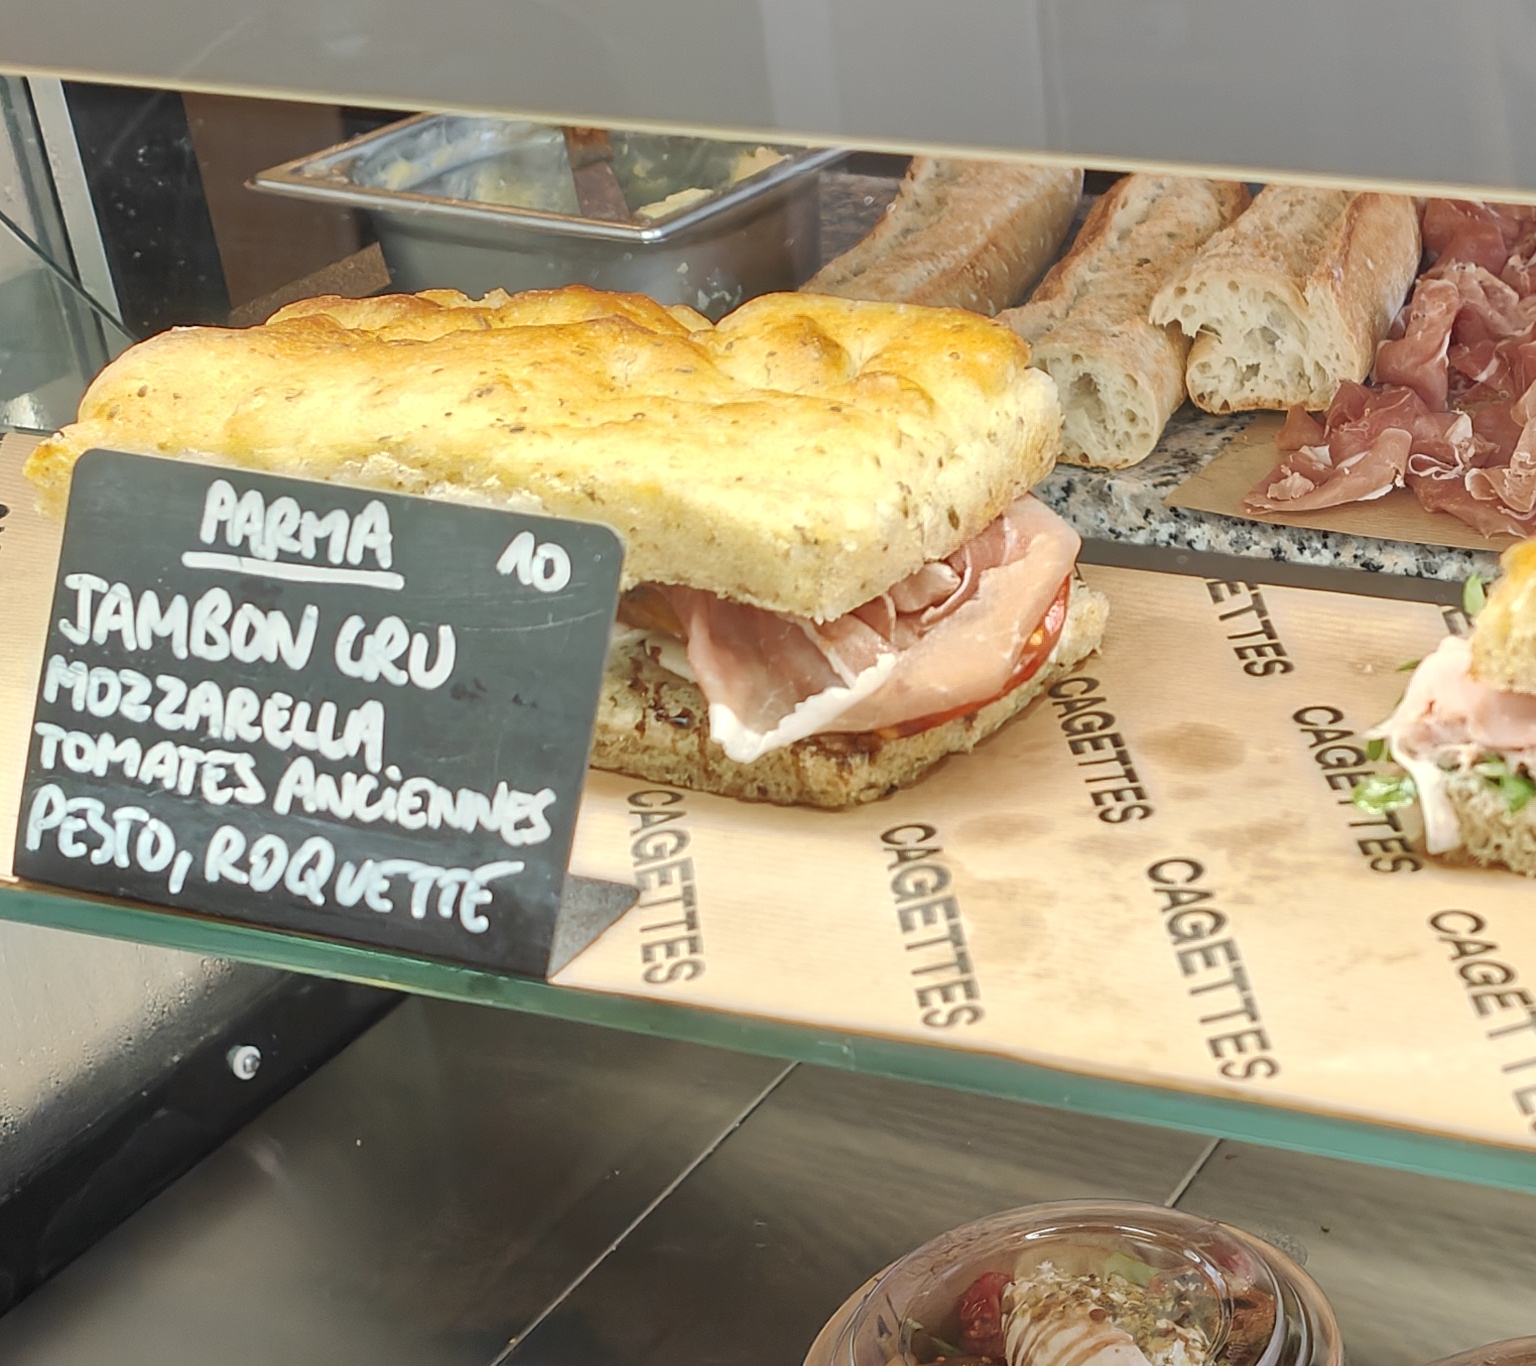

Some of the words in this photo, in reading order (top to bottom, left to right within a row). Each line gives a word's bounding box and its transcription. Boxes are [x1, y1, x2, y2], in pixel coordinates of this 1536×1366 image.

[200, 478, 394, 570] PARMA
[496, 530, 573, 593] 10
[58, 571, 319, 671] JAMBON
[334, 614, 458, 690] CRU
[34, 721, 268, 806] TOMATES
[42, 654, 387, 773] MOZZARELLA
[1047, 676, 1156, 826] CAGETTES
[24, 782, 194, 895] PESTO,
[203, 825, 526, 934] ROQUETTE
[1292, 704, 1424, 875] CAGETES
[626, 788, 706, 986] CAGETTES
[880, 821, 986, 1030] CAGETTES
[1146, 856, 1280, 1082] CAGETTES
